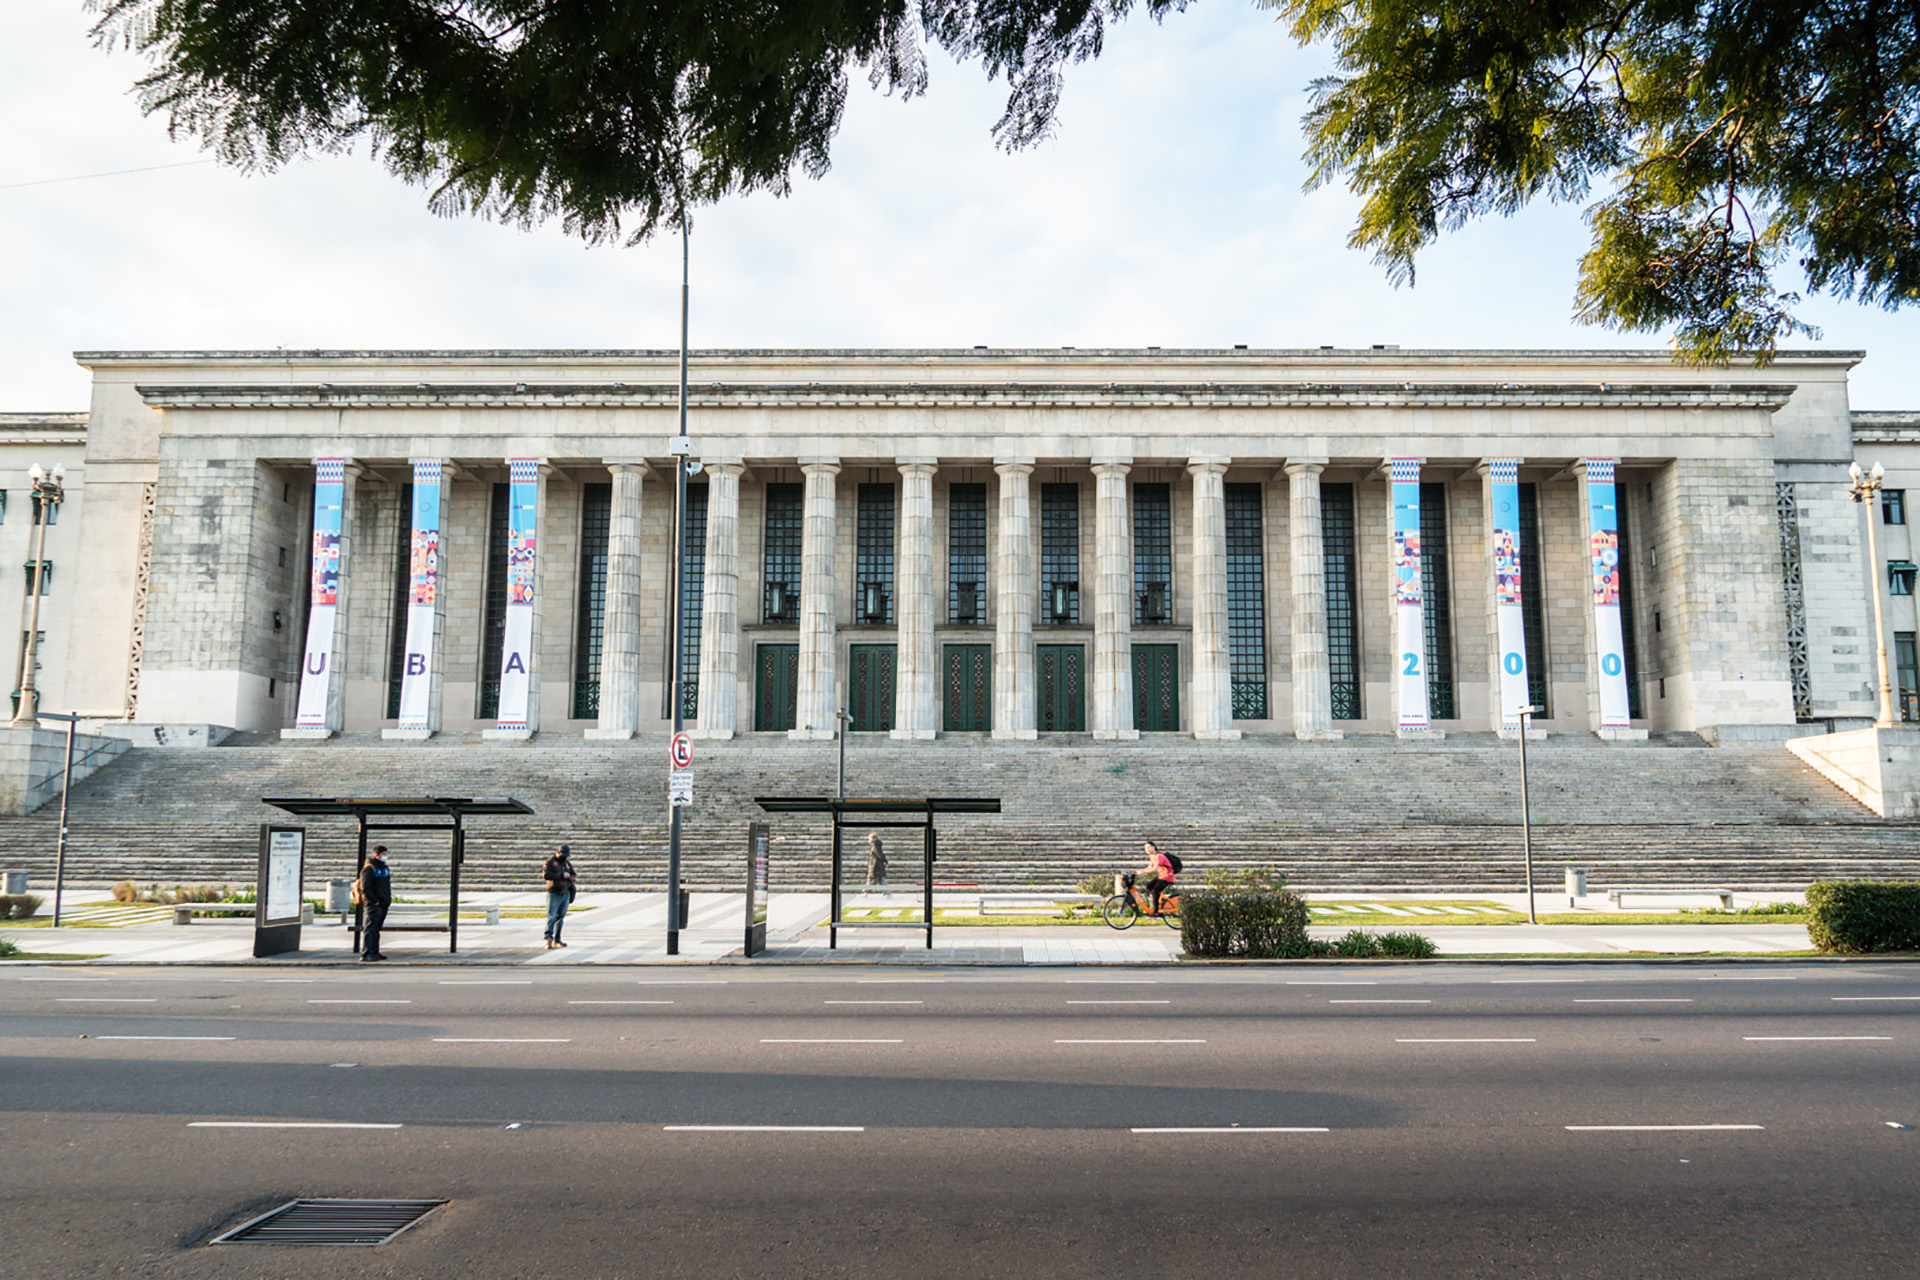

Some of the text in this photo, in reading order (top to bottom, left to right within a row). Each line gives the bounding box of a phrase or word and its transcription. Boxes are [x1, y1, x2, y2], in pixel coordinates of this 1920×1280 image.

[575, 413, 713, 430] FACULTD
[816, 413, 948, 430] DERECHO
[986, 413, 999, 430] Y
[1214, 413, 1357, 430] SOCIALES
[306, 652, 327, 675] U
[406, 653, 427, 676] B
[504, 651, 526, 674] A
[1402, 652, 1421, 676] 2
[1503, 651, 1524, 676] 0
[1601, 652, 1622, 676] 0
[678, 739, 688, 760] E
